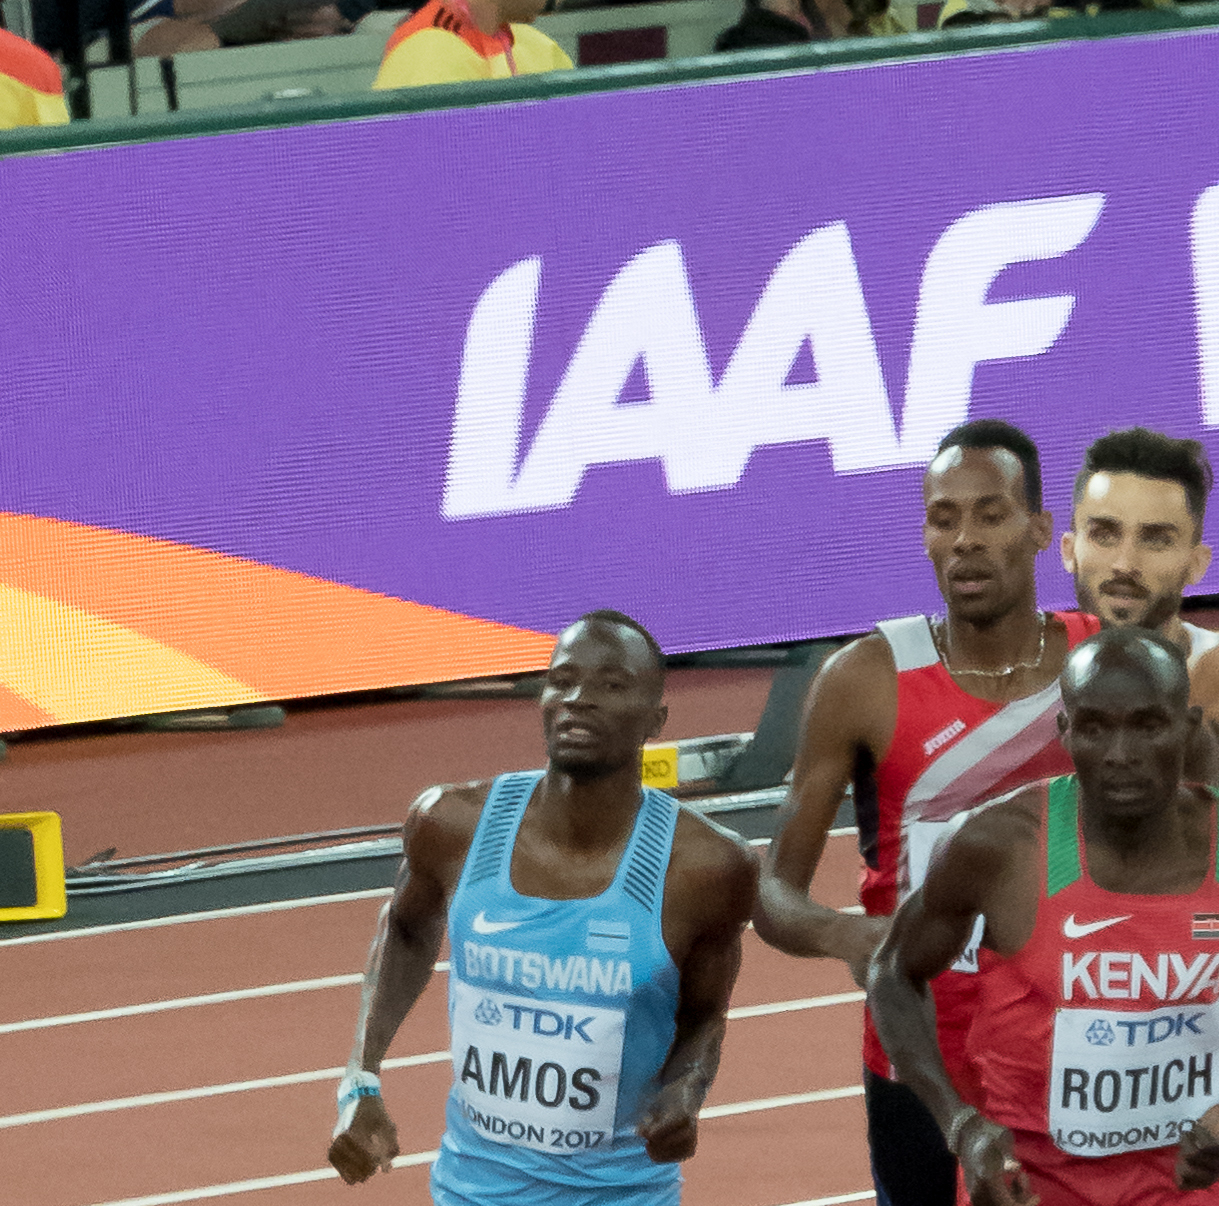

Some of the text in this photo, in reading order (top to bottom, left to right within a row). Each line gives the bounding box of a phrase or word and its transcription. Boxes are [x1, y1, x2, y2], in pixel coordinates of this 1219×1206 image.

[442, 191, 1105, 521] IAAF
[463, 940, 633, 997] BOTSWANA
[502, 1002, 597, 1044] TDK
[1116, 1012, 1206, 1047] TDK
[460, 1044, 603, 1112] AMOS
[1061, 1052, 1213, 1113] ROTICH
[550, 1128, 606, 1149] 2017
[1055, 1119, 1160, 1149] LONDON
